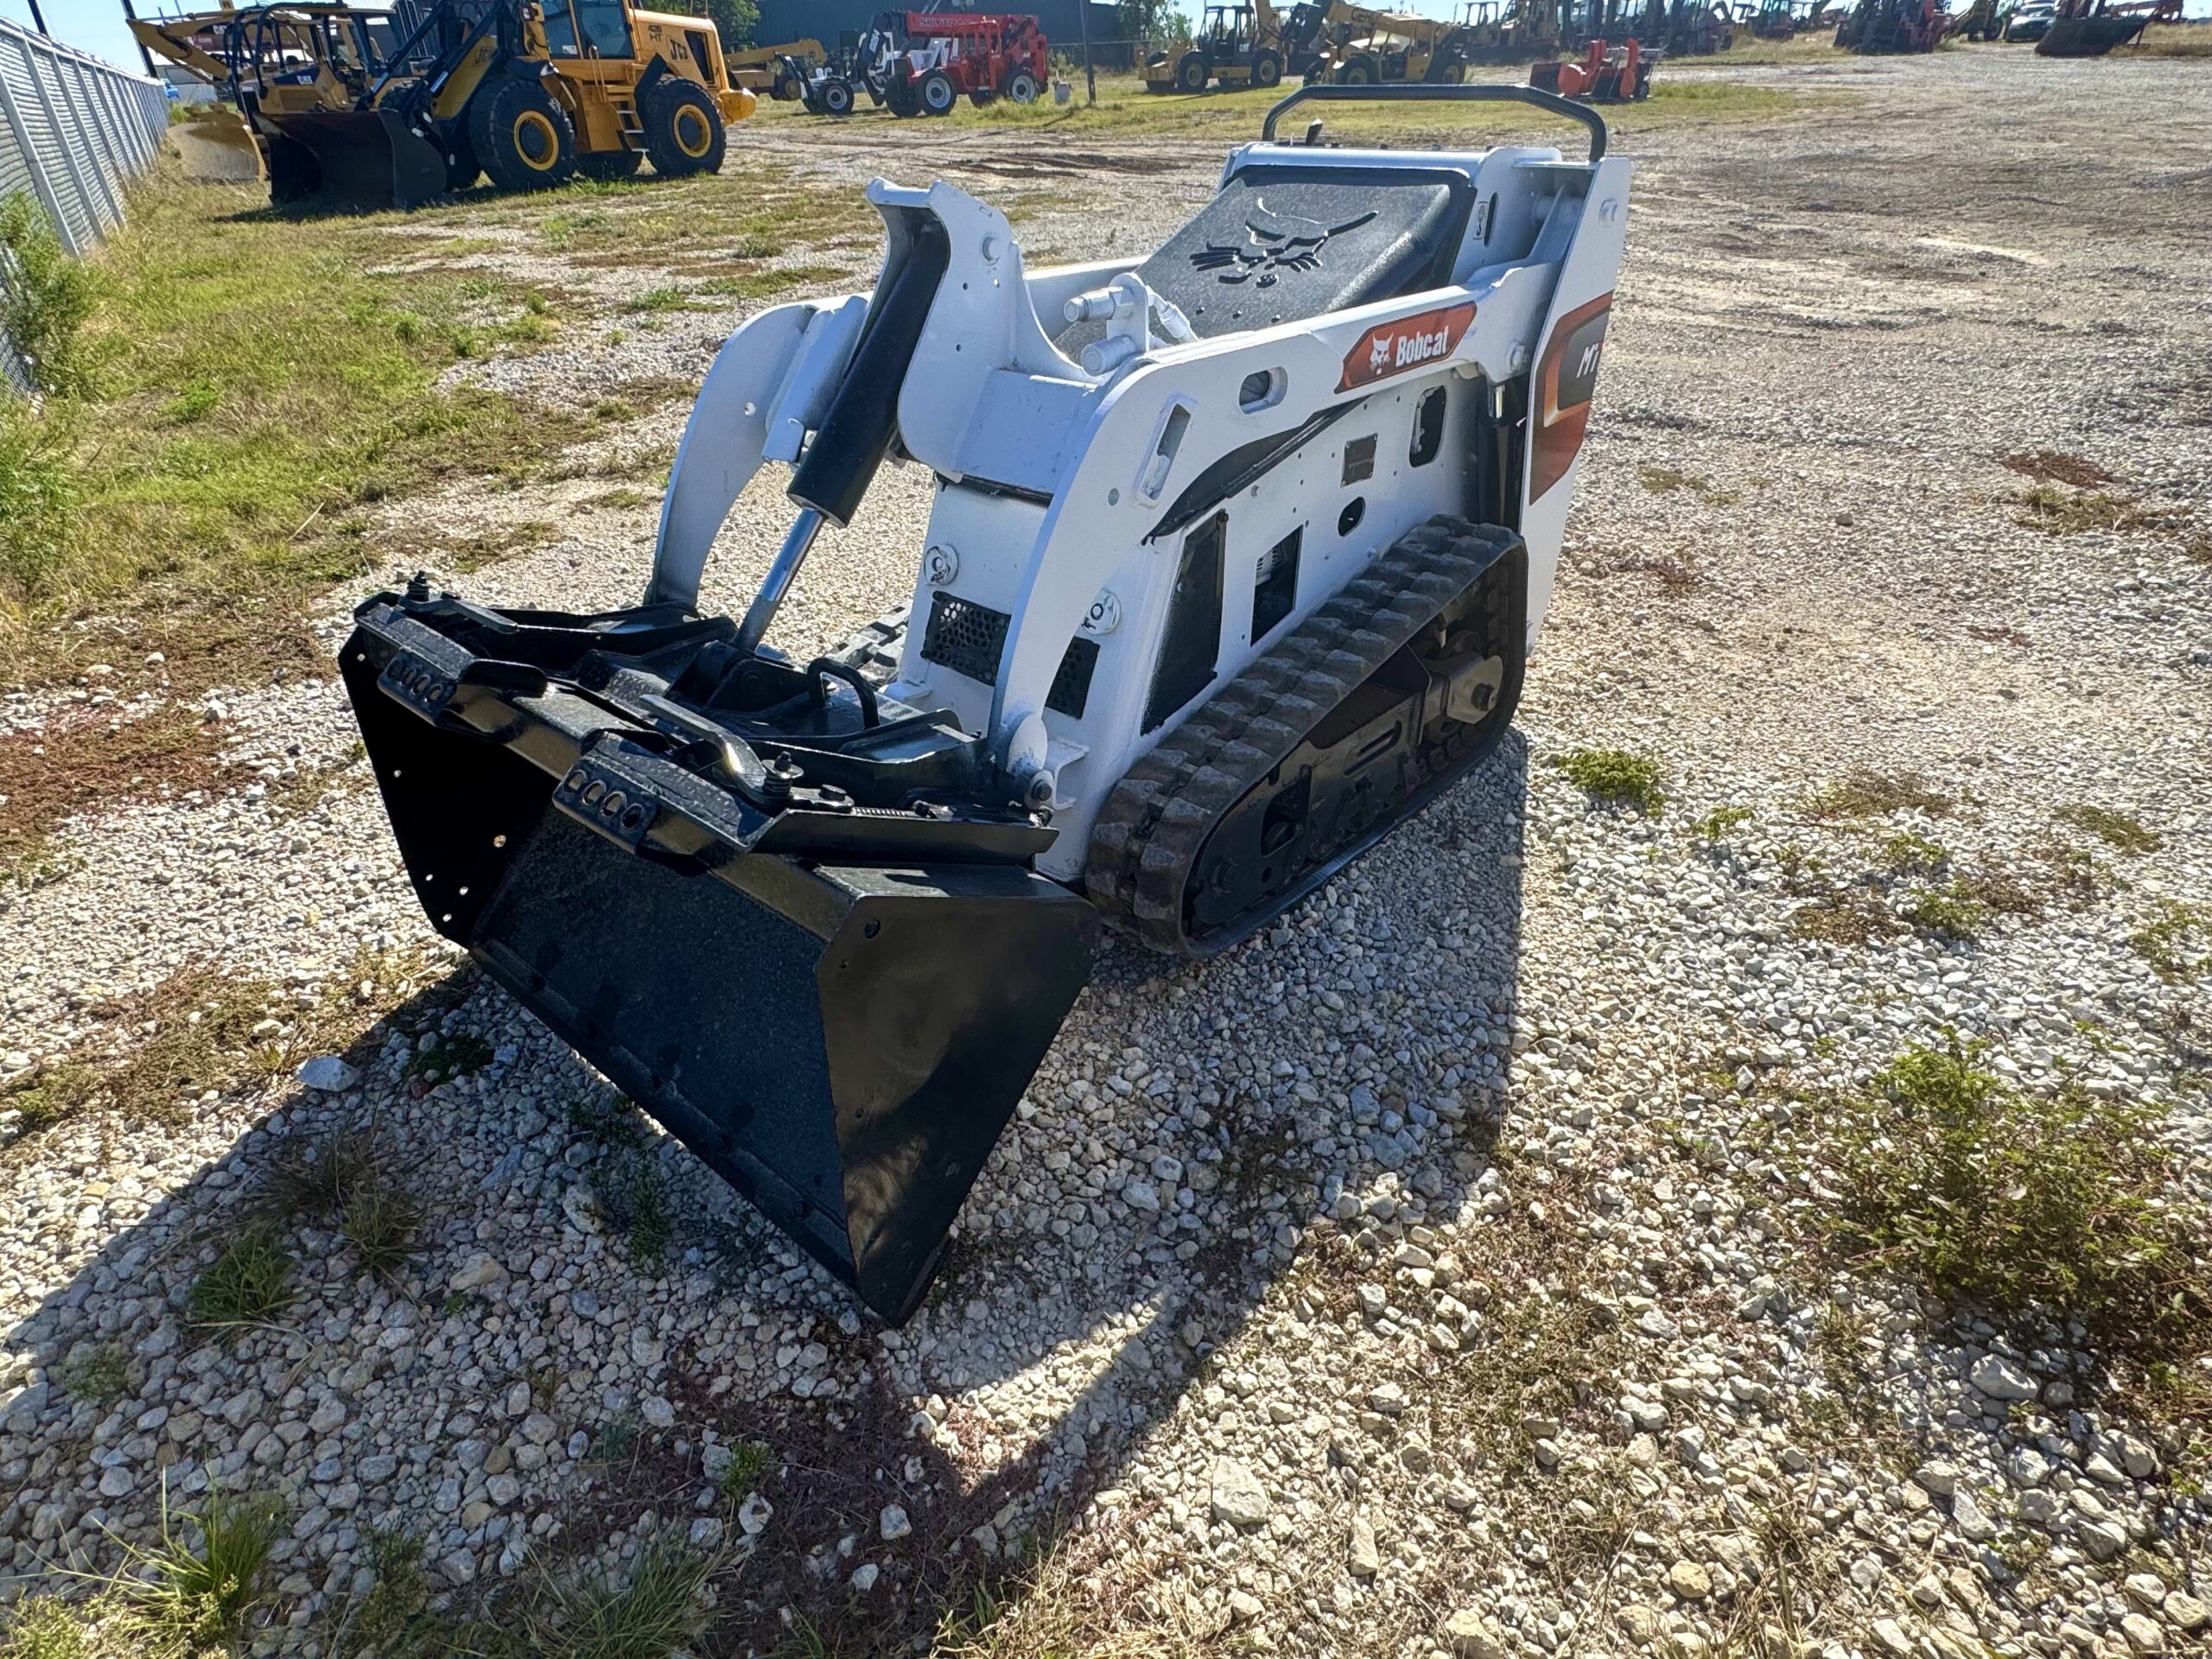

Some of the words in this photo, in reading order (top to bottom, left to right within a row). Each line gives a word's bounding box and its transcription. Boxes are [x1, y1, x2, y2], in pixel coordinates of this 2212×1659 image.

[670, 39, 689, 60] JCB
[296, 75, 314, 85] CAT
[1395, 325, 1449, 367] Bobcat
